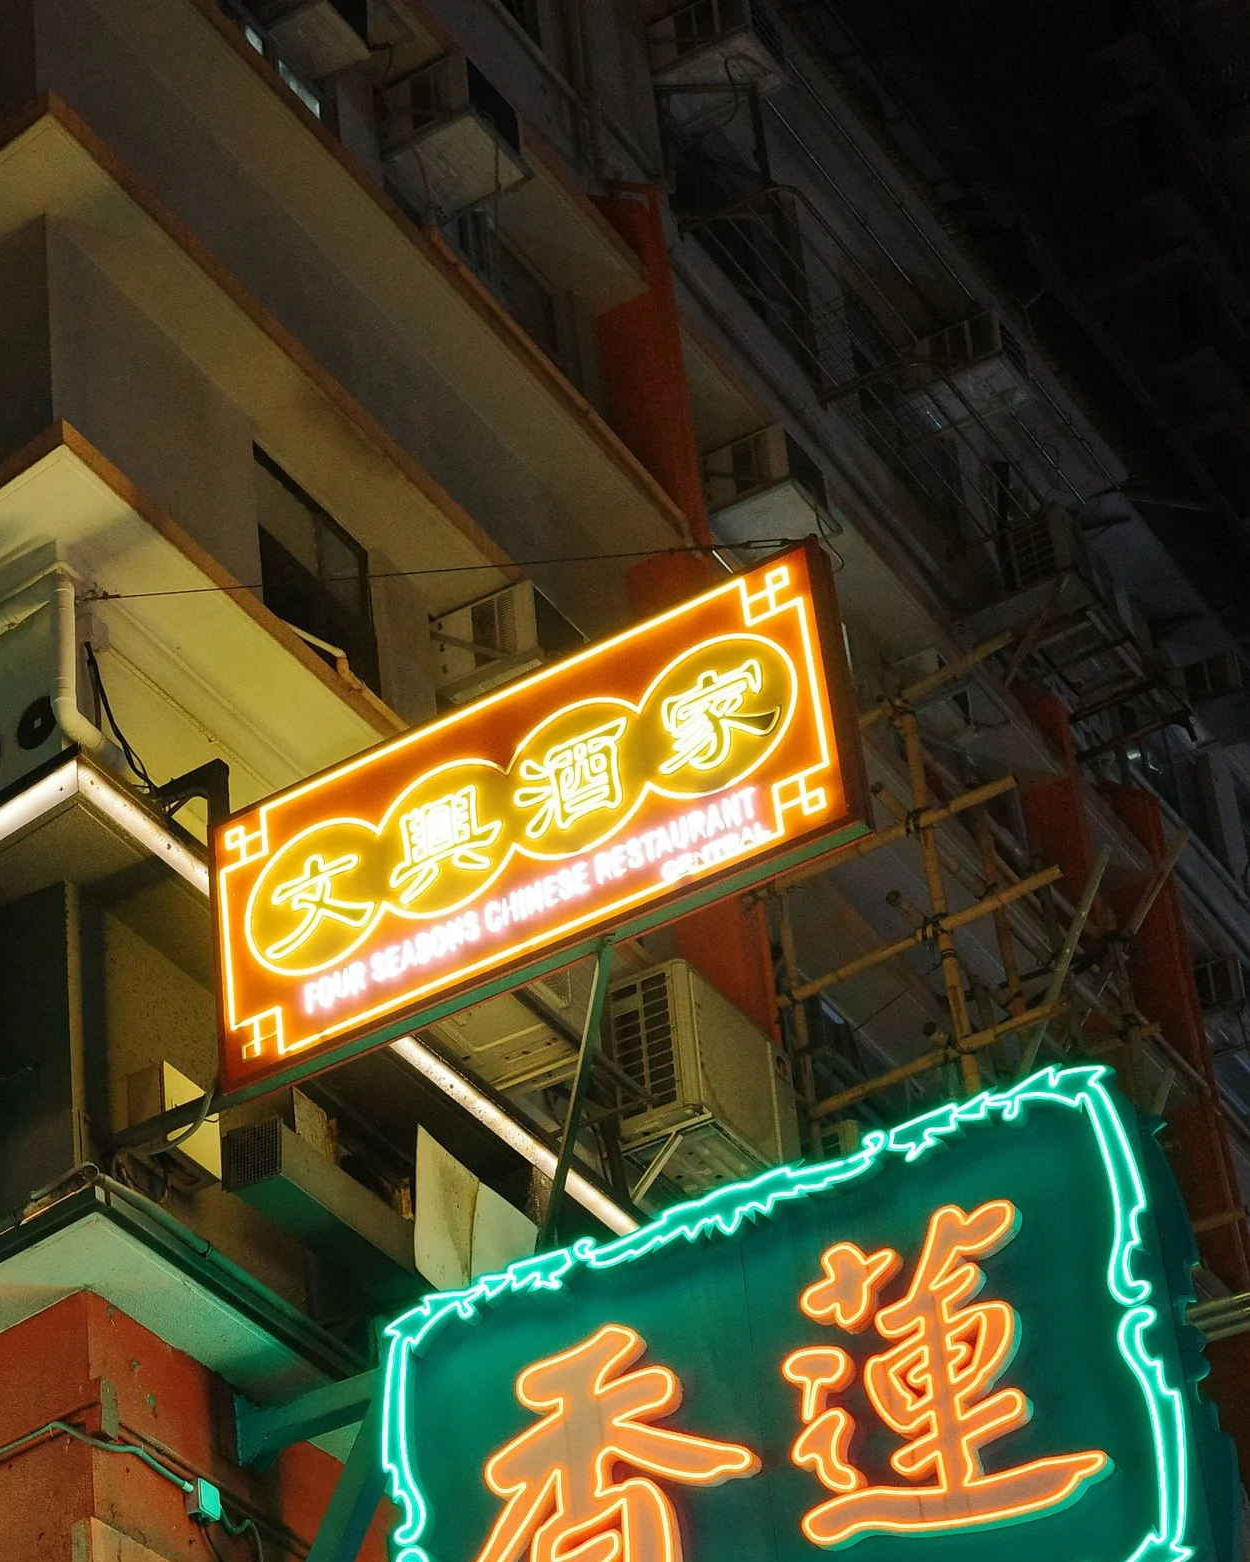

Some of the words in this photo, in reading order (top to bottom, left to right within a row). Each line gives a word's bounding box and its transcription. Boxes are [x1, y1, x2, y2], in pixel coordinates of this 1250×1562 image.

[303, 960, 368, 1015] FOUR
[370, 908, 482, 984] SEASONS
[484, 861, 591, 935] CHINESE
[594, 785, 758, 888] RESTAURANT
